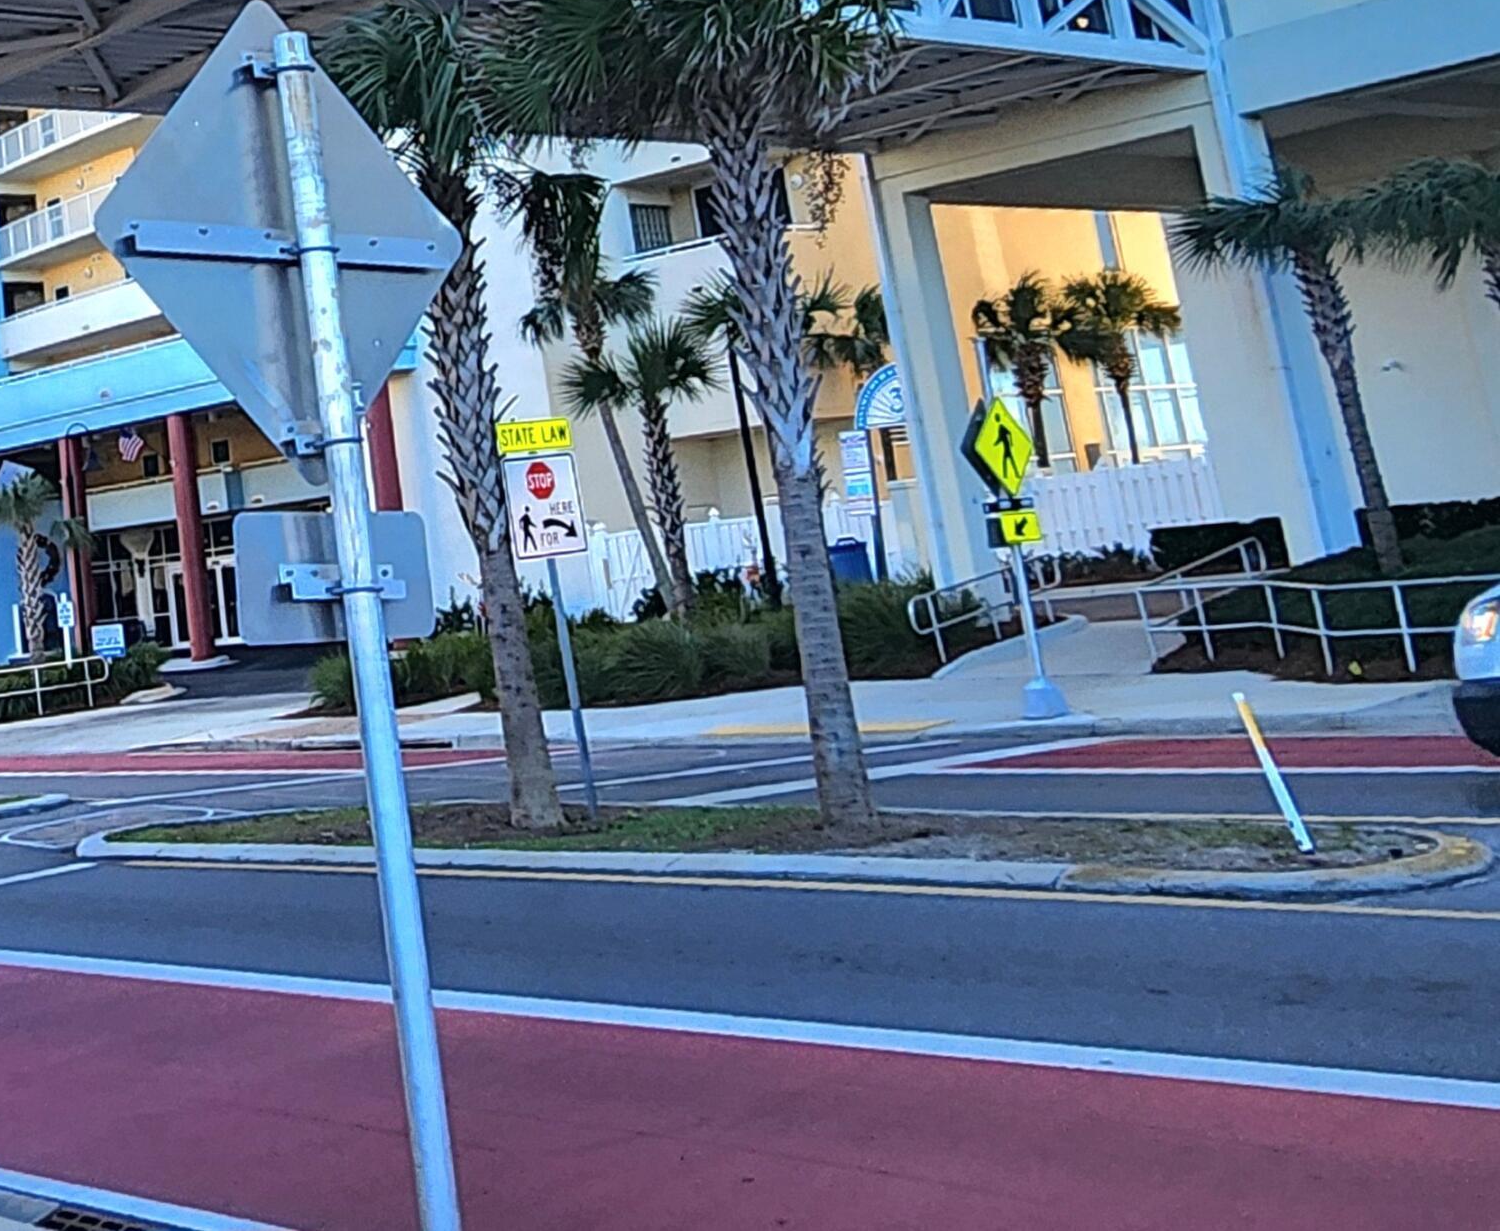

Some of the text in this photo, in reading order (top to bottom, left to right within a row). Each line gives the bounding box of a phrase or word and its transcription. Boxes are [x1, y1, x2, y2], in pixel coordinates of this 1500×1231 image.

[500, 424, 568, 447] STATE LAW
[528, 473, 553, 490] STOP
[549, 501, 575, 516] HERE
[540, 531, 560, 547] FOR
